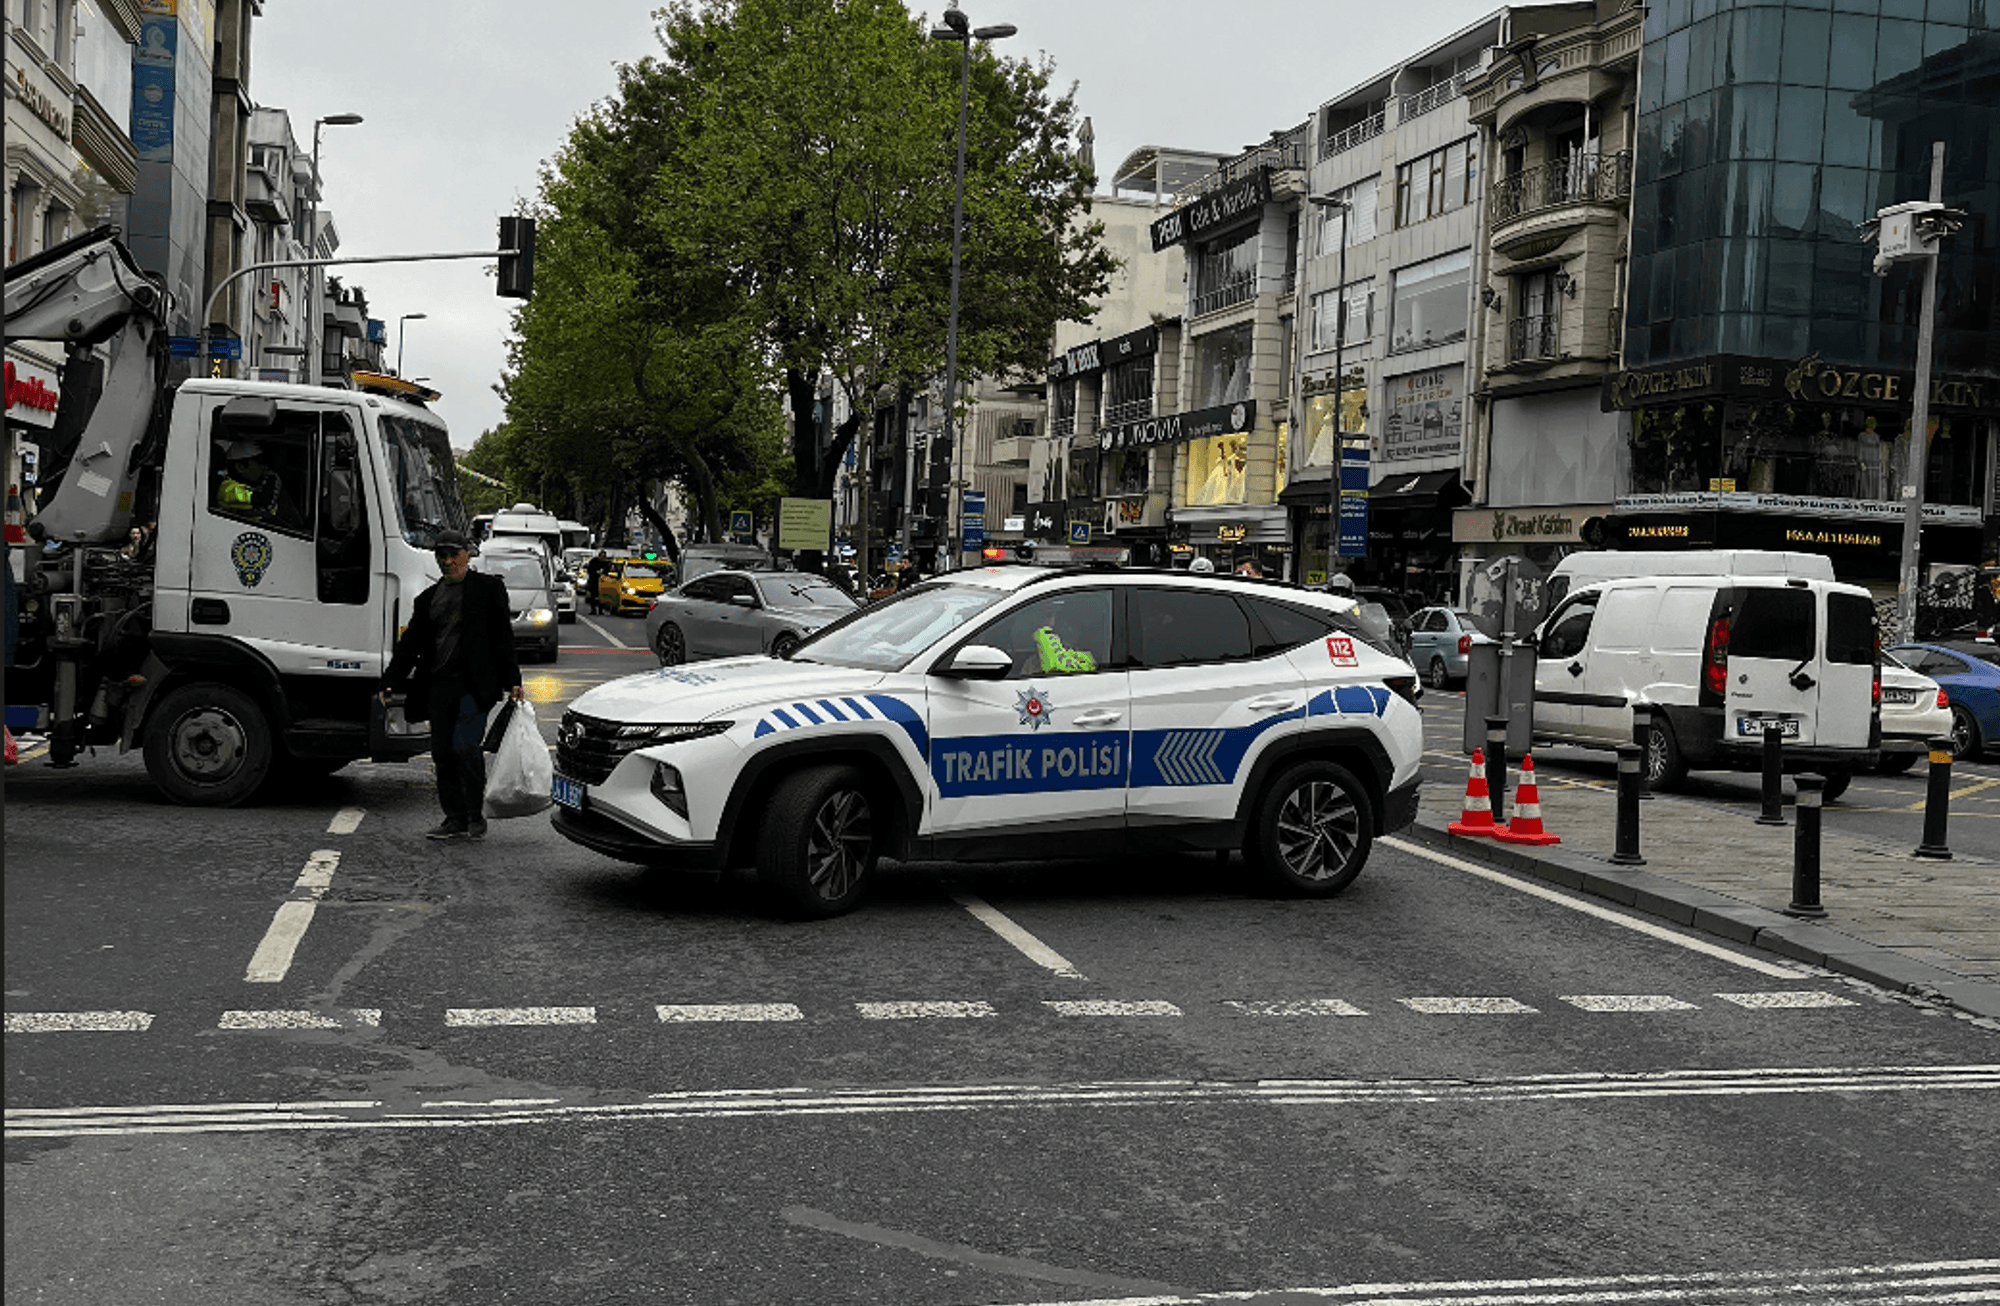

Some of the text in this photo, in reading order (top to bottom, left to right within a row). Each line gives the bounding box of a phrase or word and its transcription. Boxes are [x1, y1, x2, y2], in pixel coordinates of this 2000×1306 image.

[1818, 364, 1983, 407] ÖZGE KIN
[1331, 641, 1351, 656] 112
[942, 739, 1121, 784] TRAFİK POLİSİ
